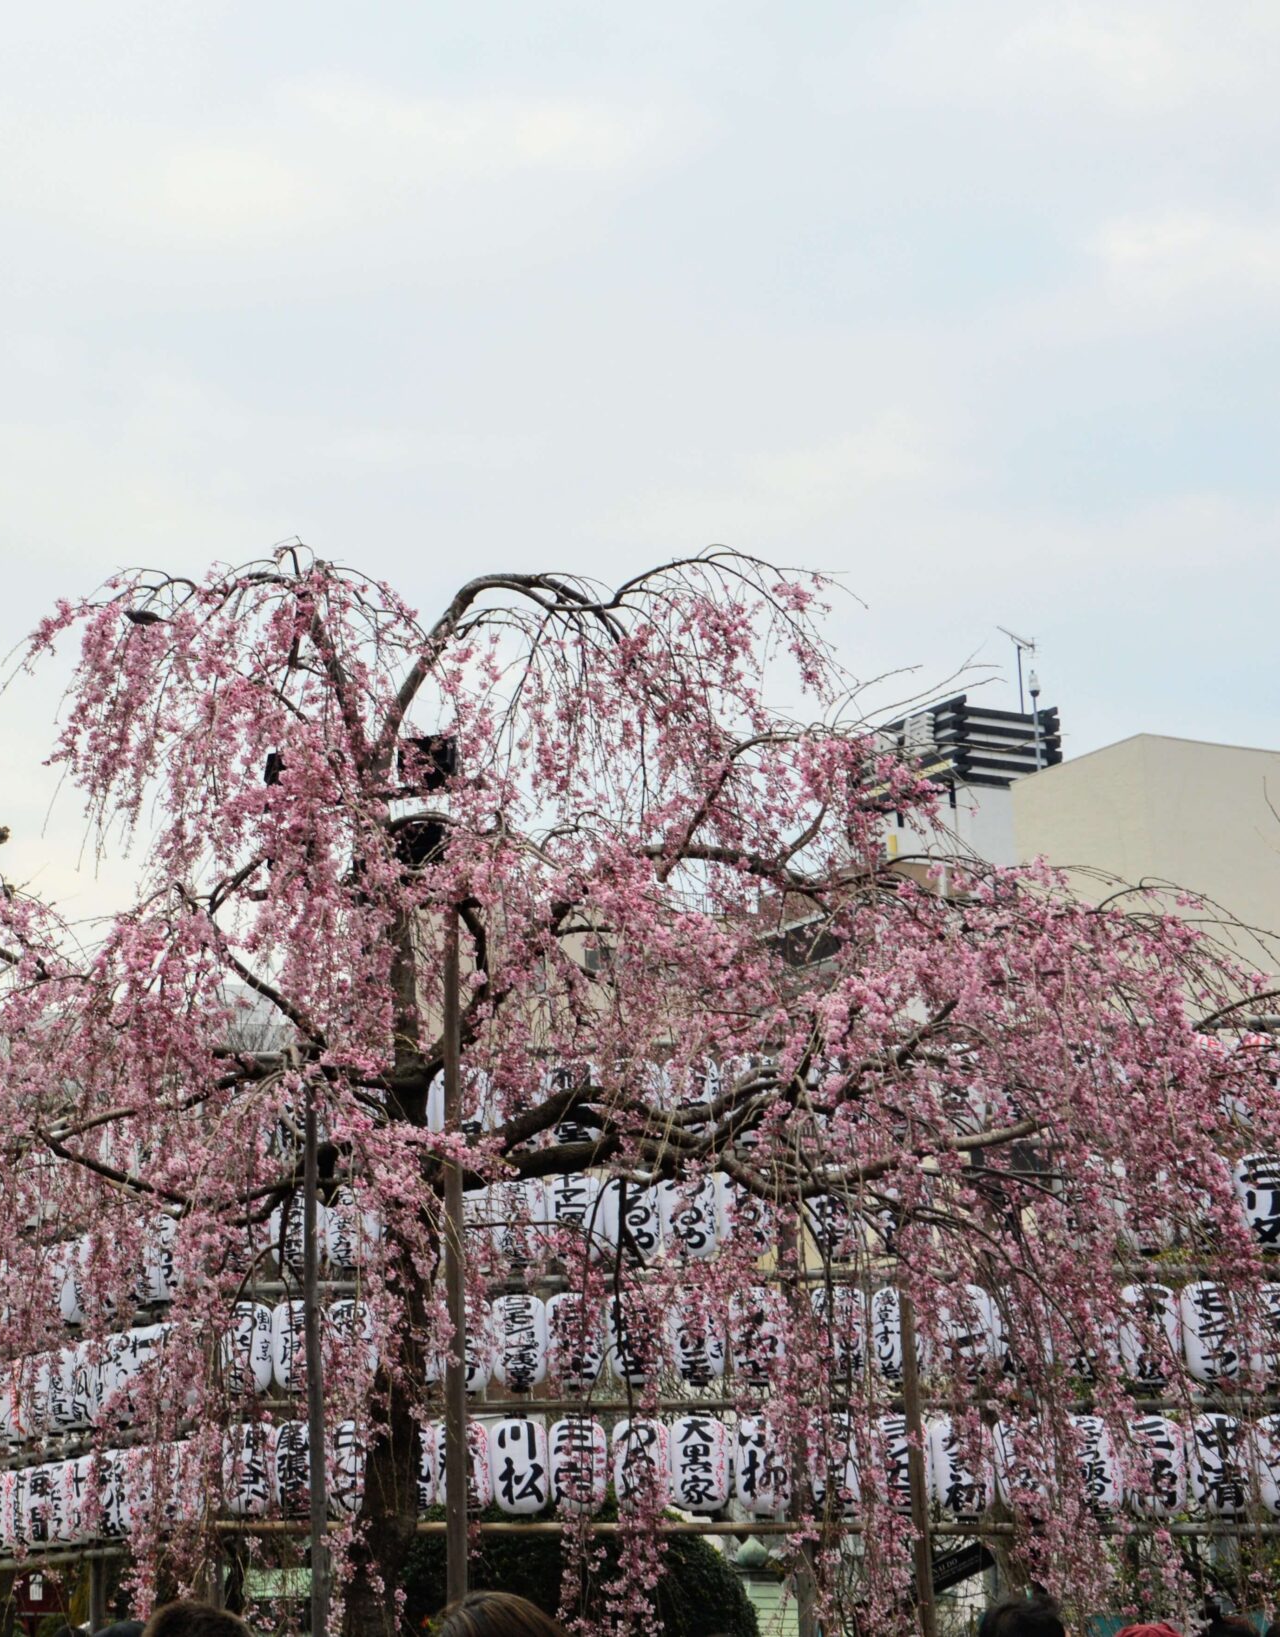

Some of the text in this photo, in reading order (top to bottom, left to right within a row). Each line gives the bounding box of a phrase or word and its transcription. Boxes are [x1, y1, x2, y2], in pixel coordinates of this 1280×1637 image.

[497, 1421, 545, 1505] 川松
[677, 1419, 718, 1505] 大黒家
[1195, 1417, 1249, 1508] 中清
